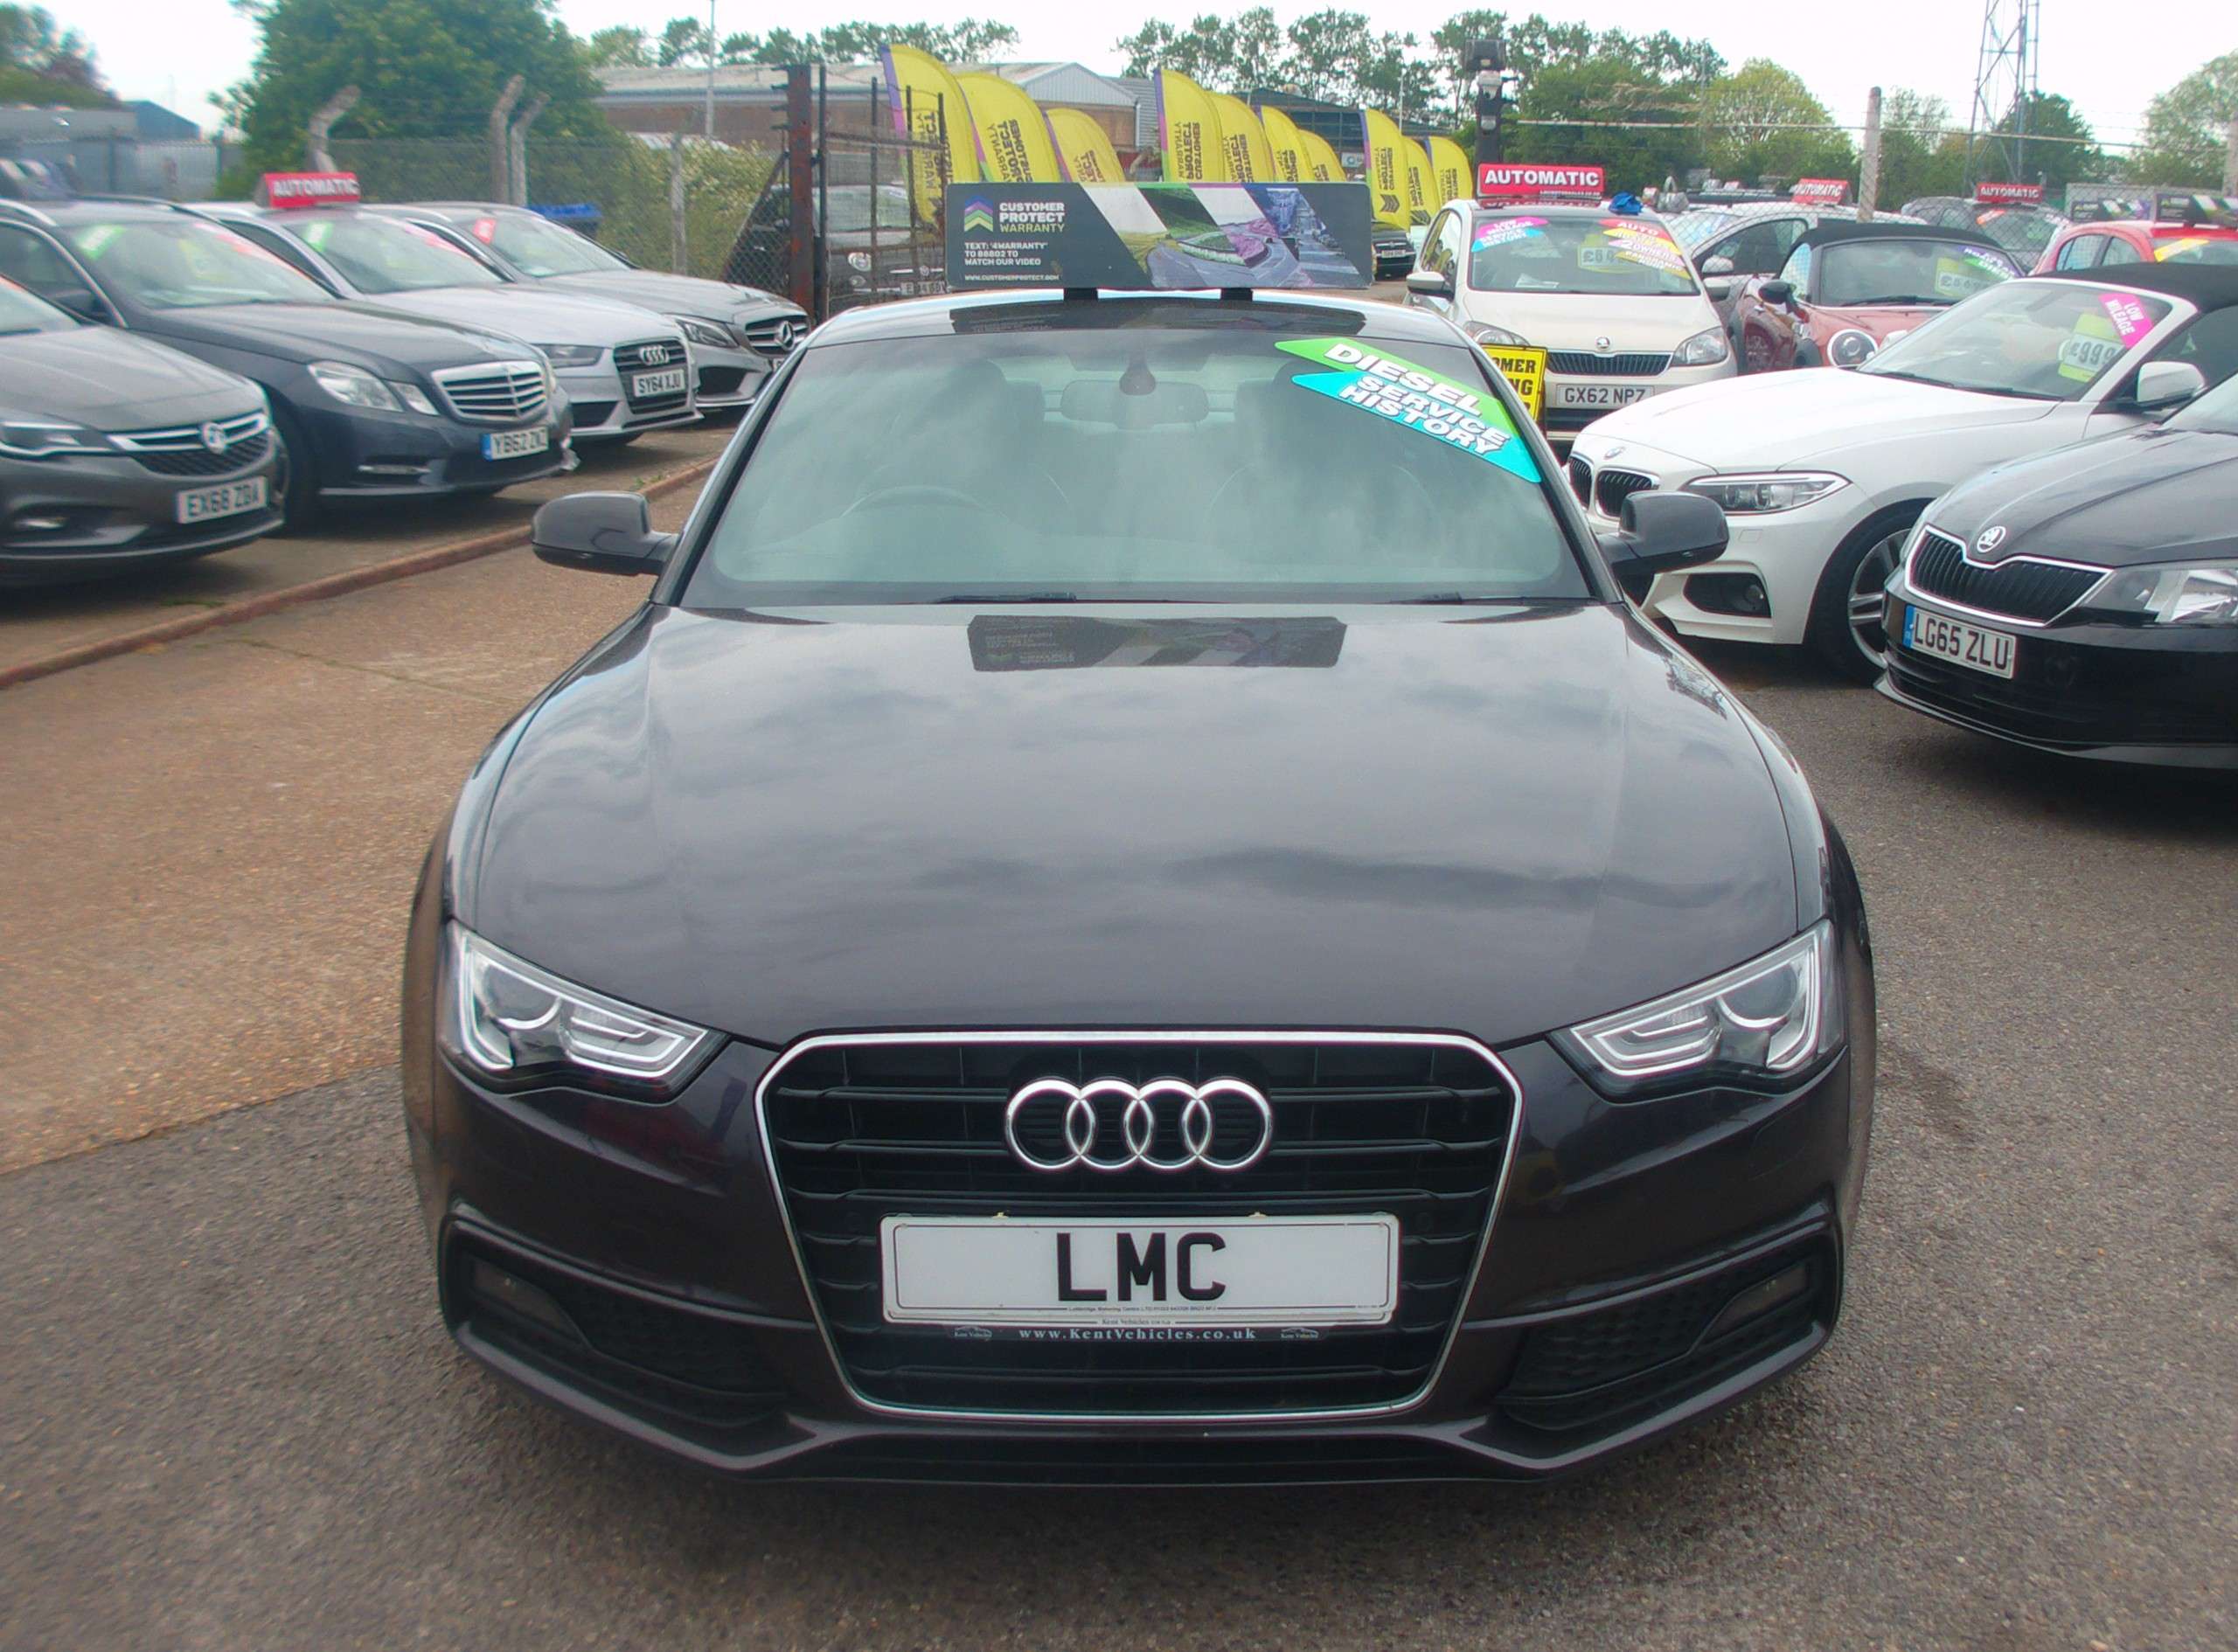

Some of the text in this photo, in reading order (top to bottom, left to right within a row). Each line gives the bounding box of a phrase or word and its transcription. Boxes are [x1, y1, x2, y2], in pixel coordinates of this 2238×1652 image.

[1484, 170, 1600, 186] AUTOMATIC
[274, 179, 359, 198] AUTOMATIC
[1980, 186, 2040, 198] AUTOMATIC
[999, 202, 1065, 212] CUSTOMER
[999, 212, 1065, 223] PROTECT
[999, 223, 1065, 233] WARRANTY
[2105, 299, 2136, 336] MILEAGE
[2123, 302, 2144, 322] LOW
[1324, 343, 1482, 417] DIESEL
[1564, 388, 1609, 404] GX62
[1339, 385, 1502, 455] HISTORY
[1357, 376, 1511, 448] SERVICE
[188, 489, 229, 517] EX68
[1915, 614, 2009, 670] LG65 ZLU
[1057, 1232, 1227, 1302] LMC
[1018, 1327, 1256, 1340] www.KentVehicles.co.uk
